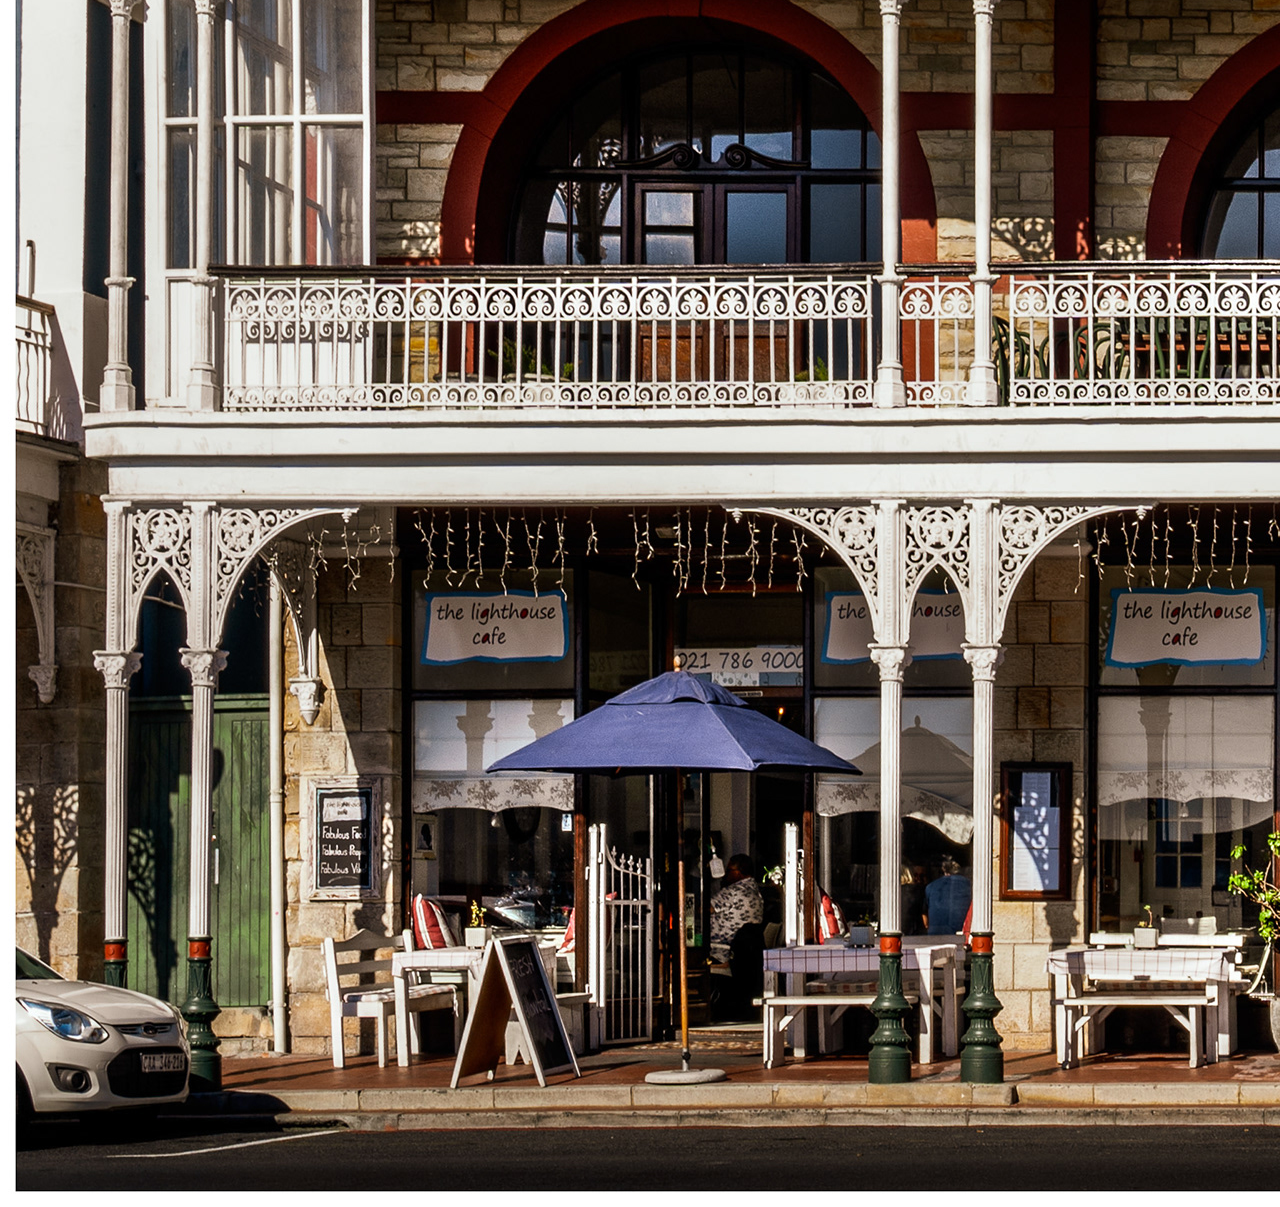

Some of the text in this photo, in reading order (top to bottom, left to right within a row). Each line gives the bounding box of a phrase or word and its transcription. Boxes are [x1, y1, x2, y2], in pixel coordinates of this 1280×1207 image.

[436, 602, 557, 627] the lighthouse
[837, 601, 961, 619] the house
[1124, 600, 1253, 625] the lighthouse
[472, 626, 507, 646] cafe
[1162, 626, 1198, 646] cafe
[678, 651, 711, 670] 021
[719, 651, 753, 670] 786
[322, 825, 367, 840] Fabulous Food
[322, 844, 348, 857] Fabulous
[320, 862, 349, 875] Fabulous
